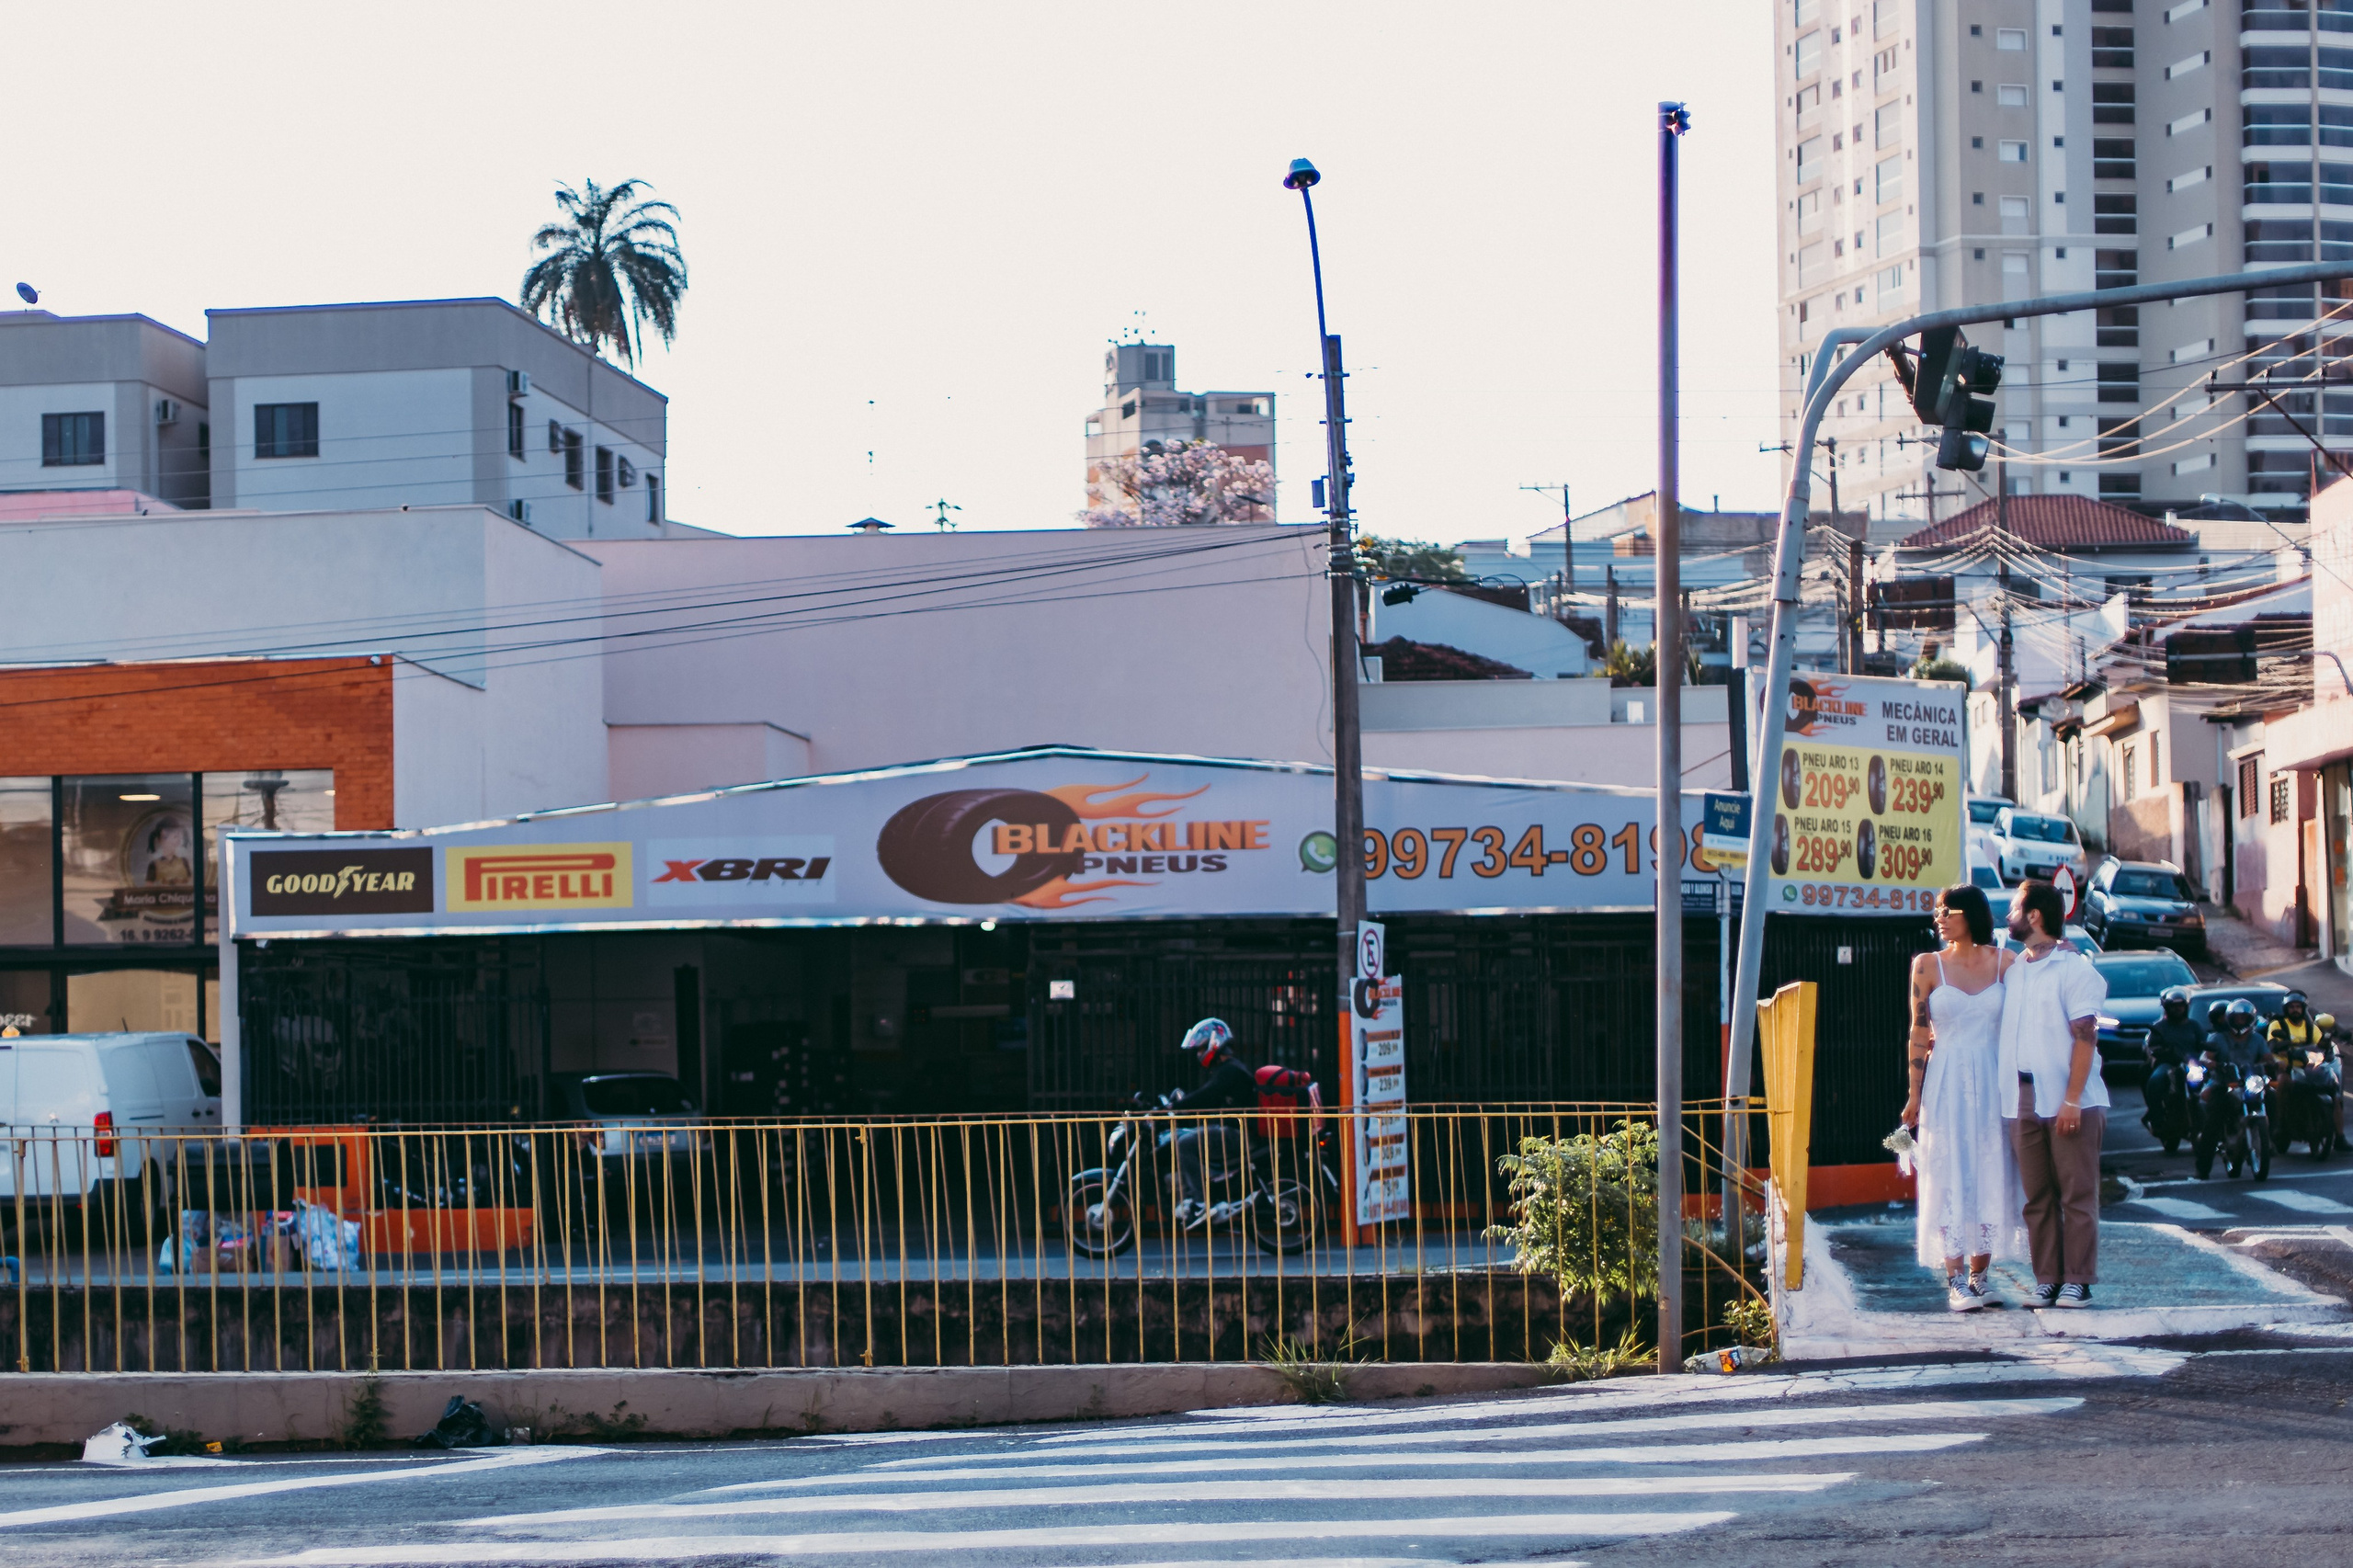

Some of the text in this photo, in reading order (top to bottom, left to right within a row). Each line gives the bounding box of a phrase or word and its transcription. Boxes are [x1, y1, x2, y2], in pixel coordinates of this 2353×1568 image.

[1792, 695, 1867, 717] BLACKLINE
[1881, 700, 1957, 725] MECÂNICA
[1816, 712, 1857, 726] PNEUS
[1886, 724, 1959, 747] EM GERAL
[1802, 752, 1859, 771] PNEU ARO 13
[1890, 758, 1944, 777] PNEU ARO 14
[1713, 798, 1742, 814] Anuncie
[1718, 815, 1736, 832] Aqui
[1794, 816, 1852, 835] PNEU ARO 15
[992, 820, 1270, 855] BLACKLINE
[1879, 825, 1933, 843] PNEU ARO 16
[649, 857, 832, 882] XBRI
[1074, 854, 1228, 874] PNEUS
[464, 853, 615, 902] PIRELLI
[123, 894, 156, 905] Maria
[1802, 883, 1936, 912] 99734-819
